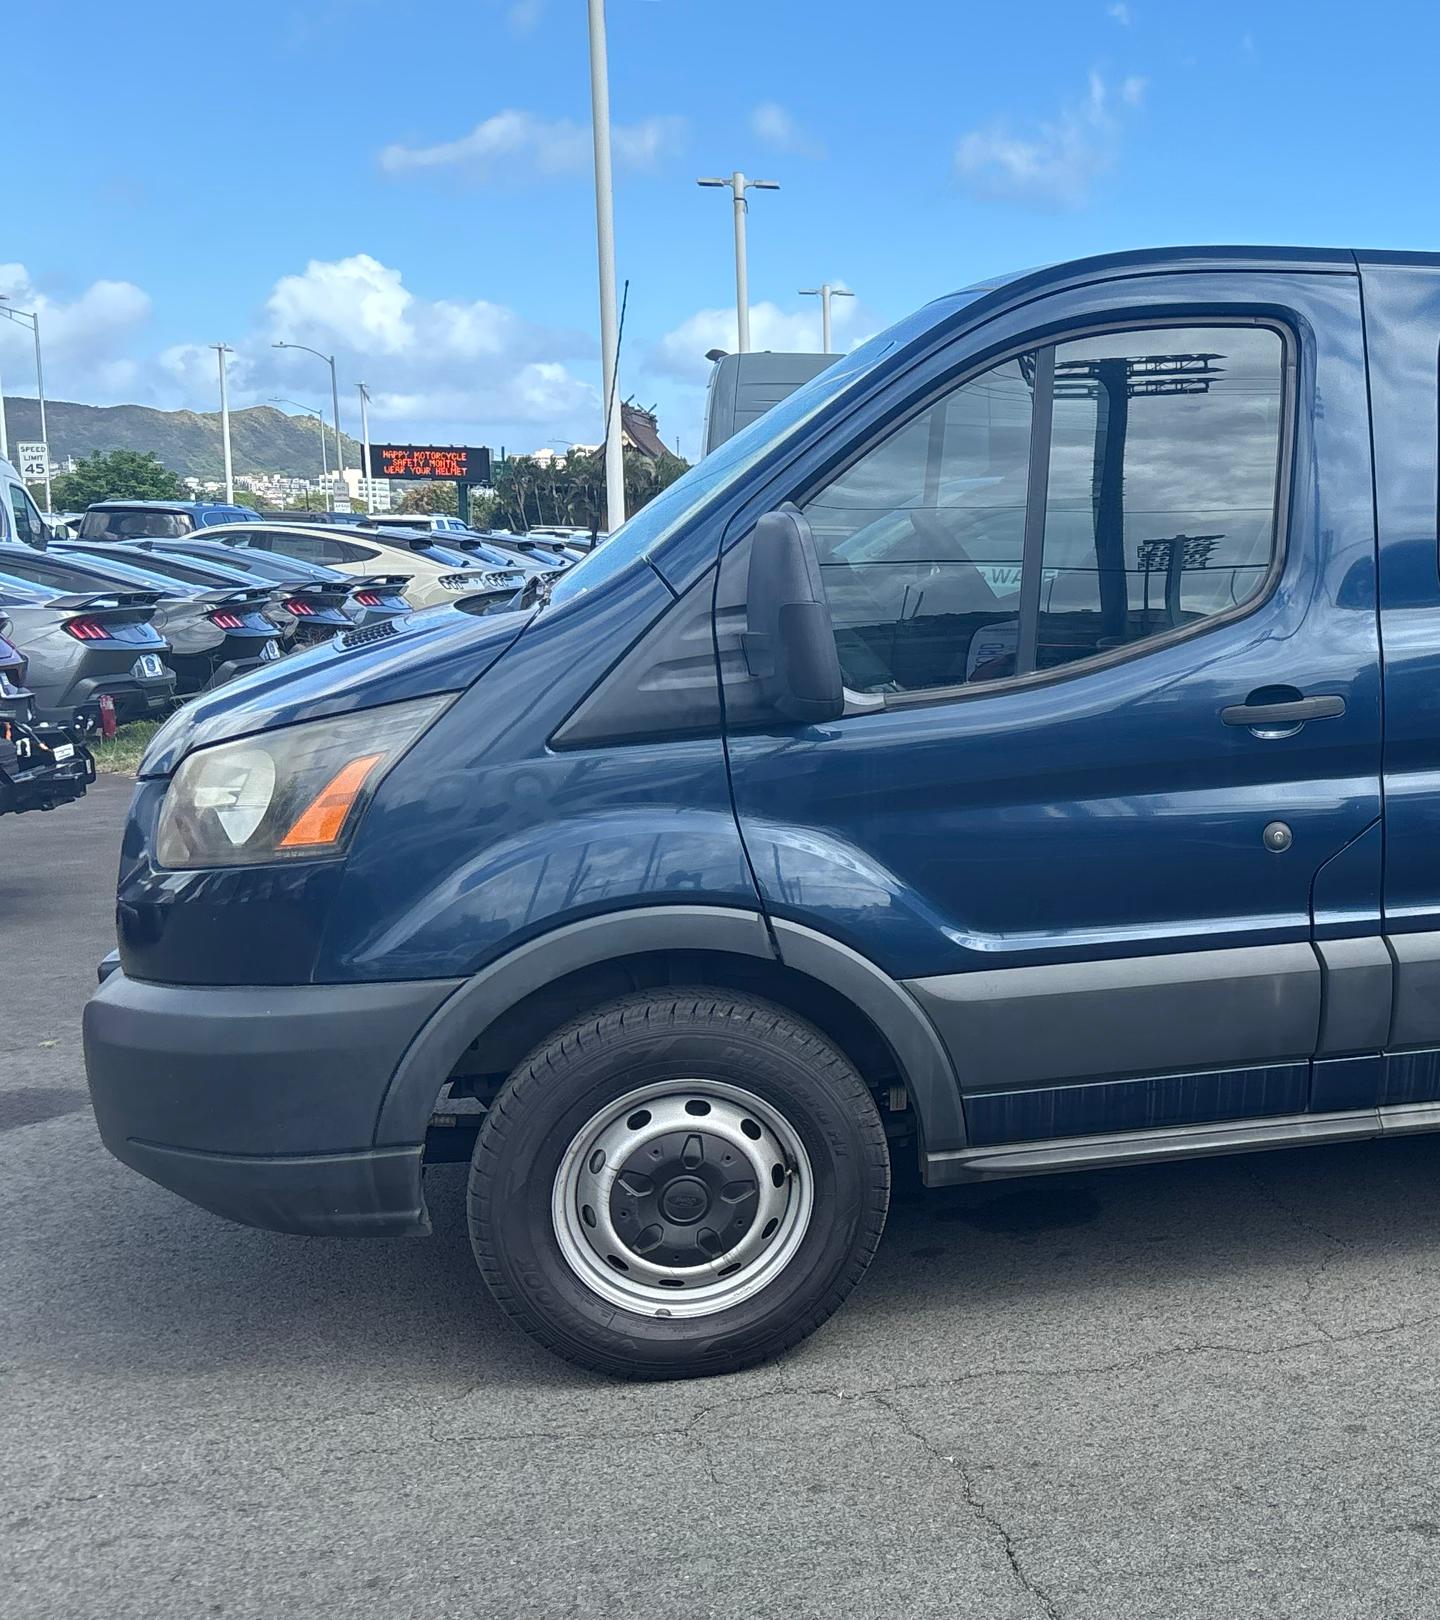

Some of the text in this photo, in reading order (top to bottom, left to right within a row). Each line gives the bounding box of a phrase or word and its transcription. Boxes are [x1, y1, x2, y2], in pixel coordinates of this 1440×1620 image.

[382, 450, 467, 461] HAPPY MOTORCYCLE
[25, 463, 45, 474] 45
[392, 458, 457, 468] SAFETY MONTH
[384, 465, 467, 476] WEAR YOUR HELMET
